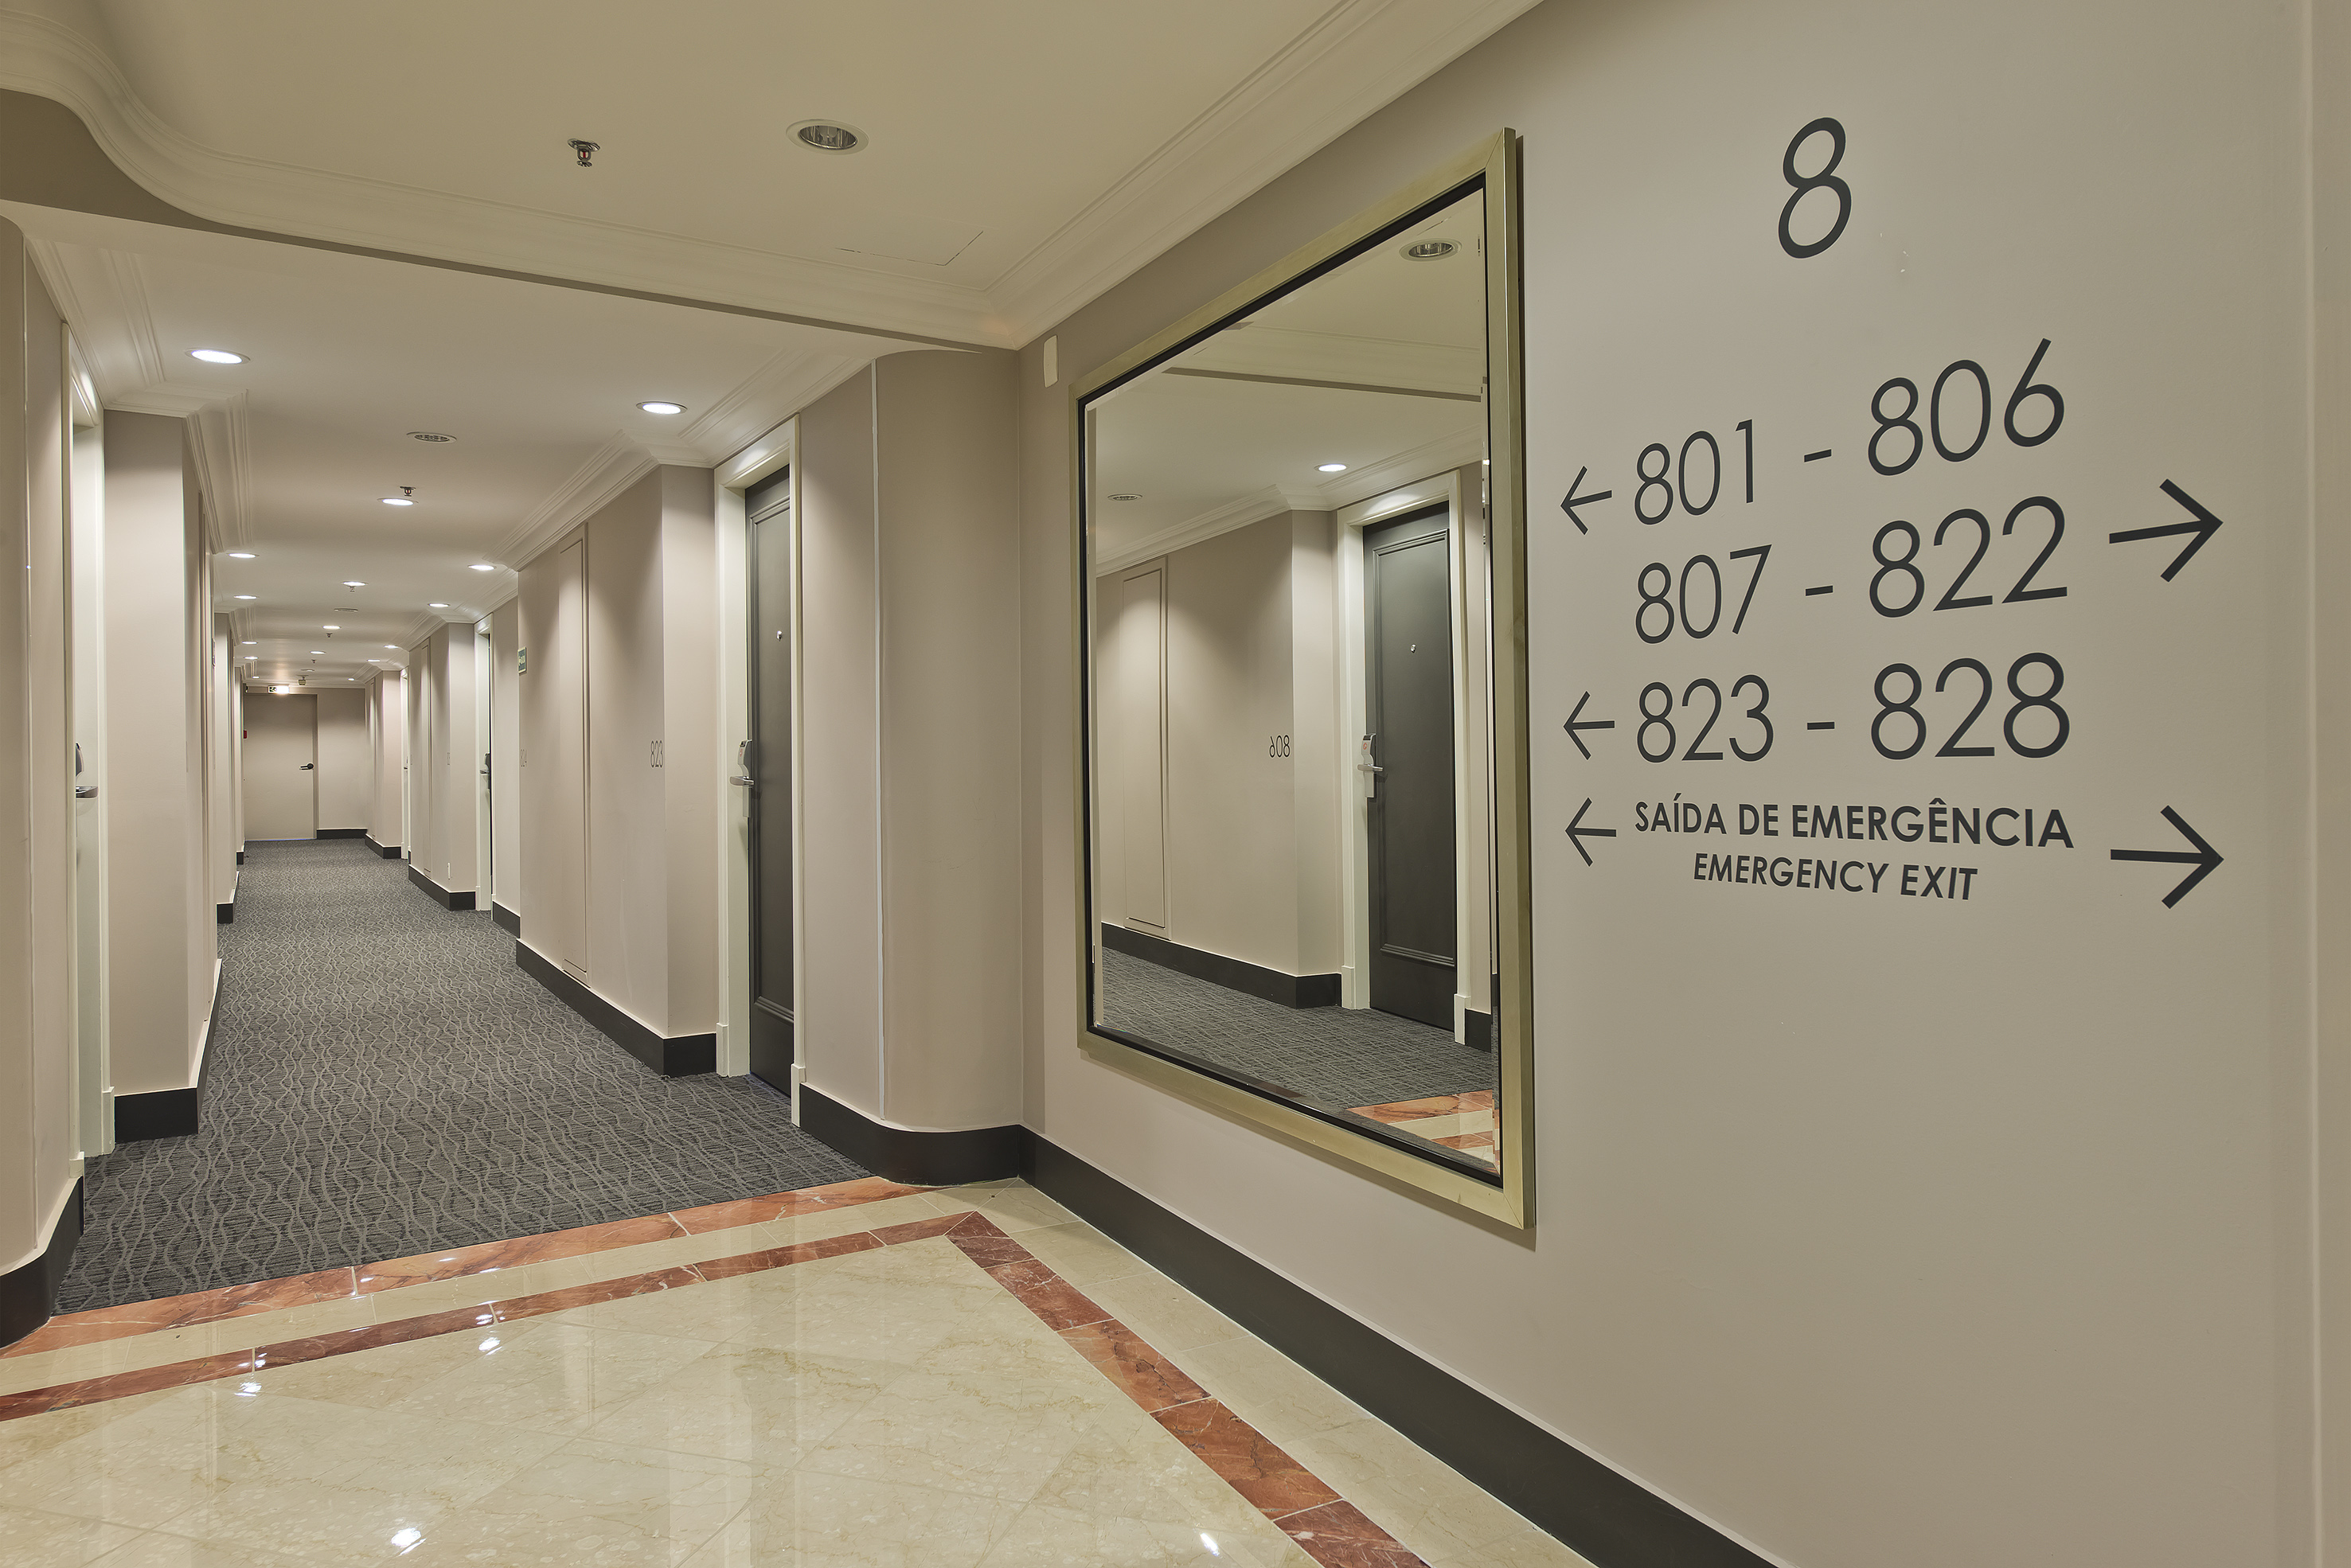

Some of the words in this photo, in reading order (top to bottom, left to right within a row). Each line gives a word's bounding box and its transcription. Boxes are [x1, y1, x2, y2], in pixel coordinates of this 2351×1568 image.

[1778, 117, 1852, 259] 8
[1634, 419, 1754, 525] 801
[1803, 448, 1832, 463] -
[1867, 337, 2064, 476] 806
[1635, 544, 1772, 645] 807
[1805, 585, 1834, 597] -
[1869, 496, 2068, 618] 822
[650, 740, 664, 767] 823
[1637, 674, 1774, 763] 823
[1871, 652, 2070, 760] 828
[1634, 793, 1727, 835] SAÍDA
[1739, 803, 1779, 837] DE
[1792, 798, 2075, 848] EMERGÊNCIA
[1693, 852, 1889, 894] EMERGENCY
[1900, 864, 1978, 900] EXIT
